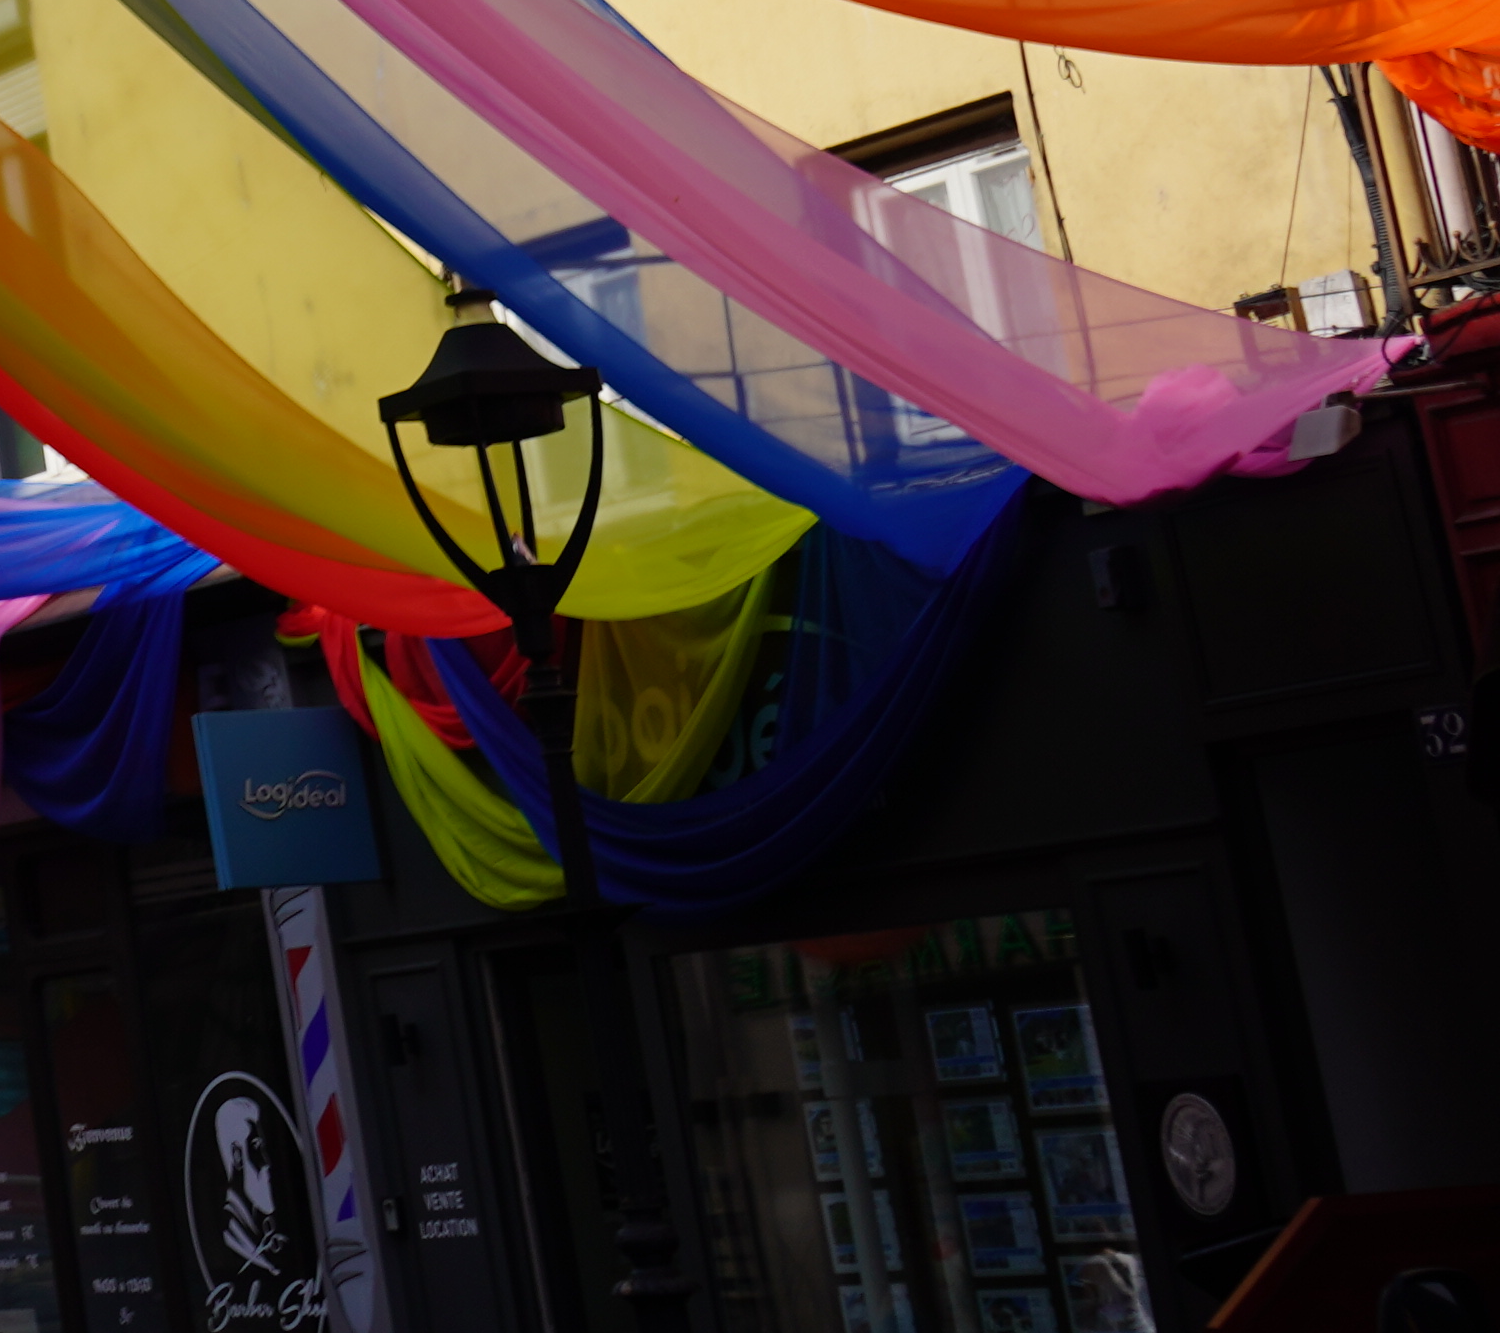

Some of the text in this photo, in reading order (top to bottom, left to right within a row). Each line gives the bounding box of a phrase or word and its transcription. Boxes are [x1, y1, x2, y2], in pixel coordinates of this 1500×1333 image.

[1418, 711, 1466, 758] 32
[67, 1123, 133, 1152] Bienvenue
[420, 1162, 459, 1184] ACHAT
[423, 1190, 465, 1211] VENTE
[419, 1217, 480, 1239] LOCATION
[205, 1278, 276, 1333] Barber
